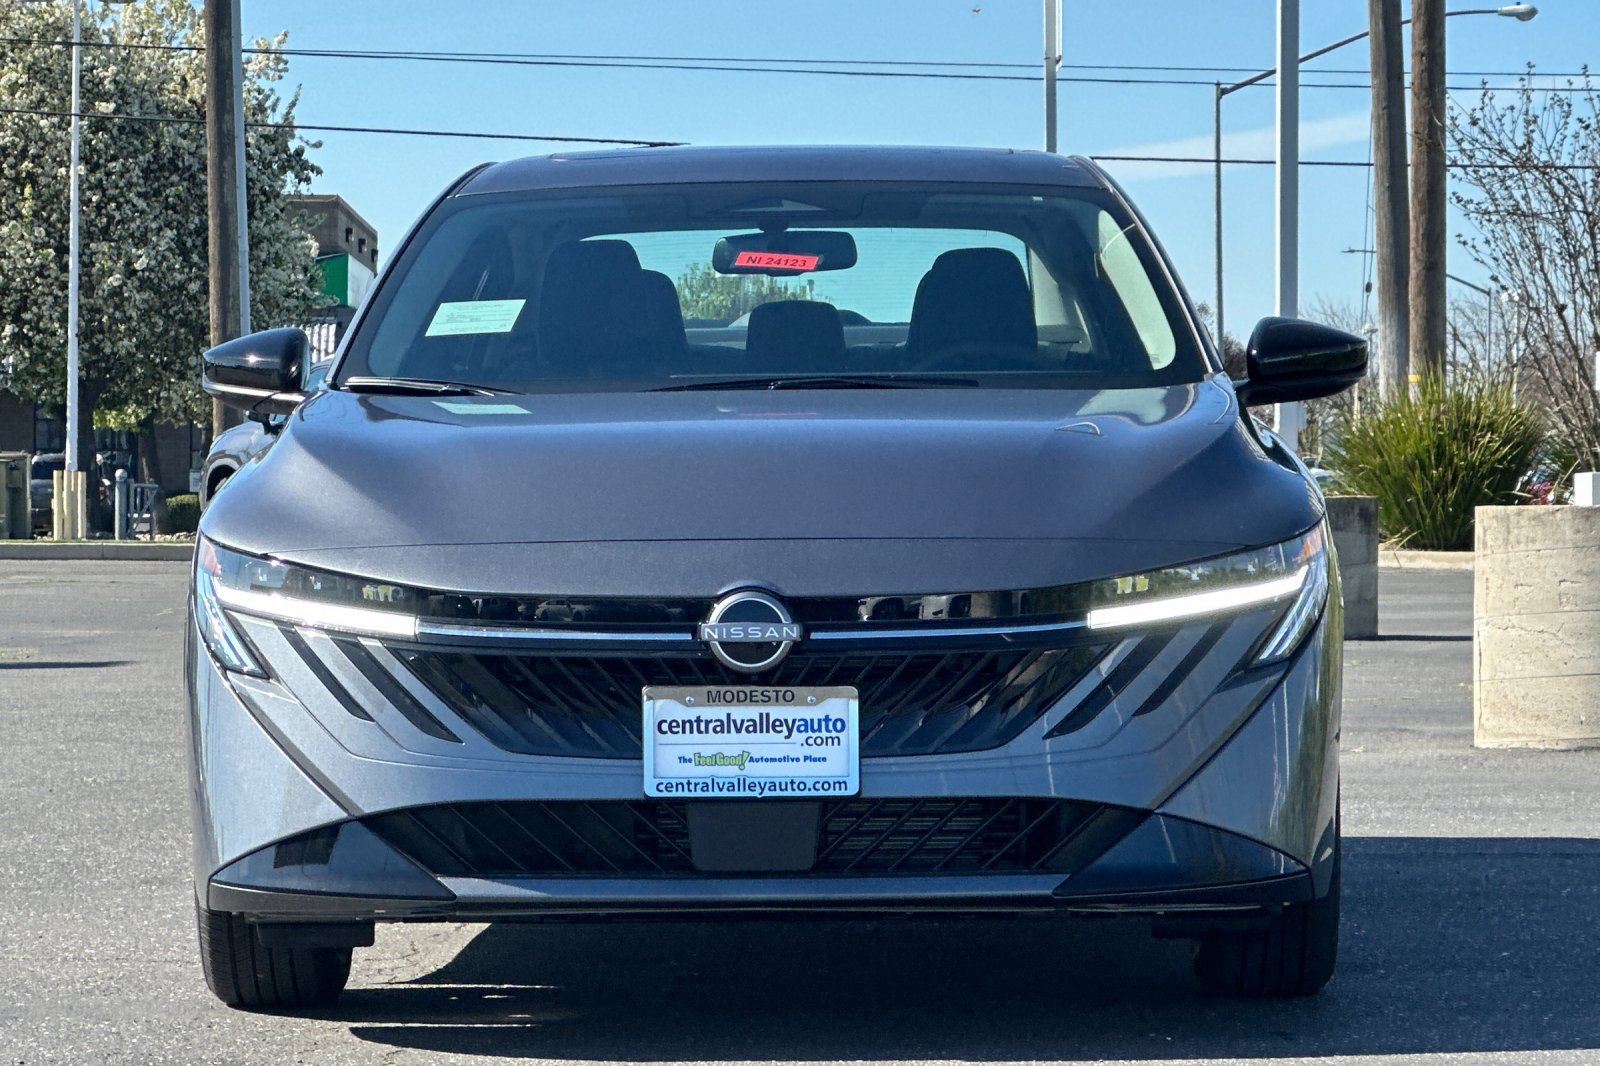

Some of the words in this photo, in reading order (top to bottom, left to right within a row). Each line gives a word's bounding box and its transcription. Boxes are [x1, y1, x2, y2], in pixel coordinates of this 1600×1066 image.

[746, 256, 762, 265] NI
[766, 257, 807, 267] 24123
[704, 626, 797, 640] NISSAN
[706, 689, 795, 704] MODESTO
[656, 712, 846, 740] centralvalleyauto
[800, 735, 841, 747] .com
[678, 756, 693, 764] The
[748, 755, 800, 764] Automotive
[803, 755, 827, 763] Place
[655, 776, 848, 796] centralvalleyauto.com
